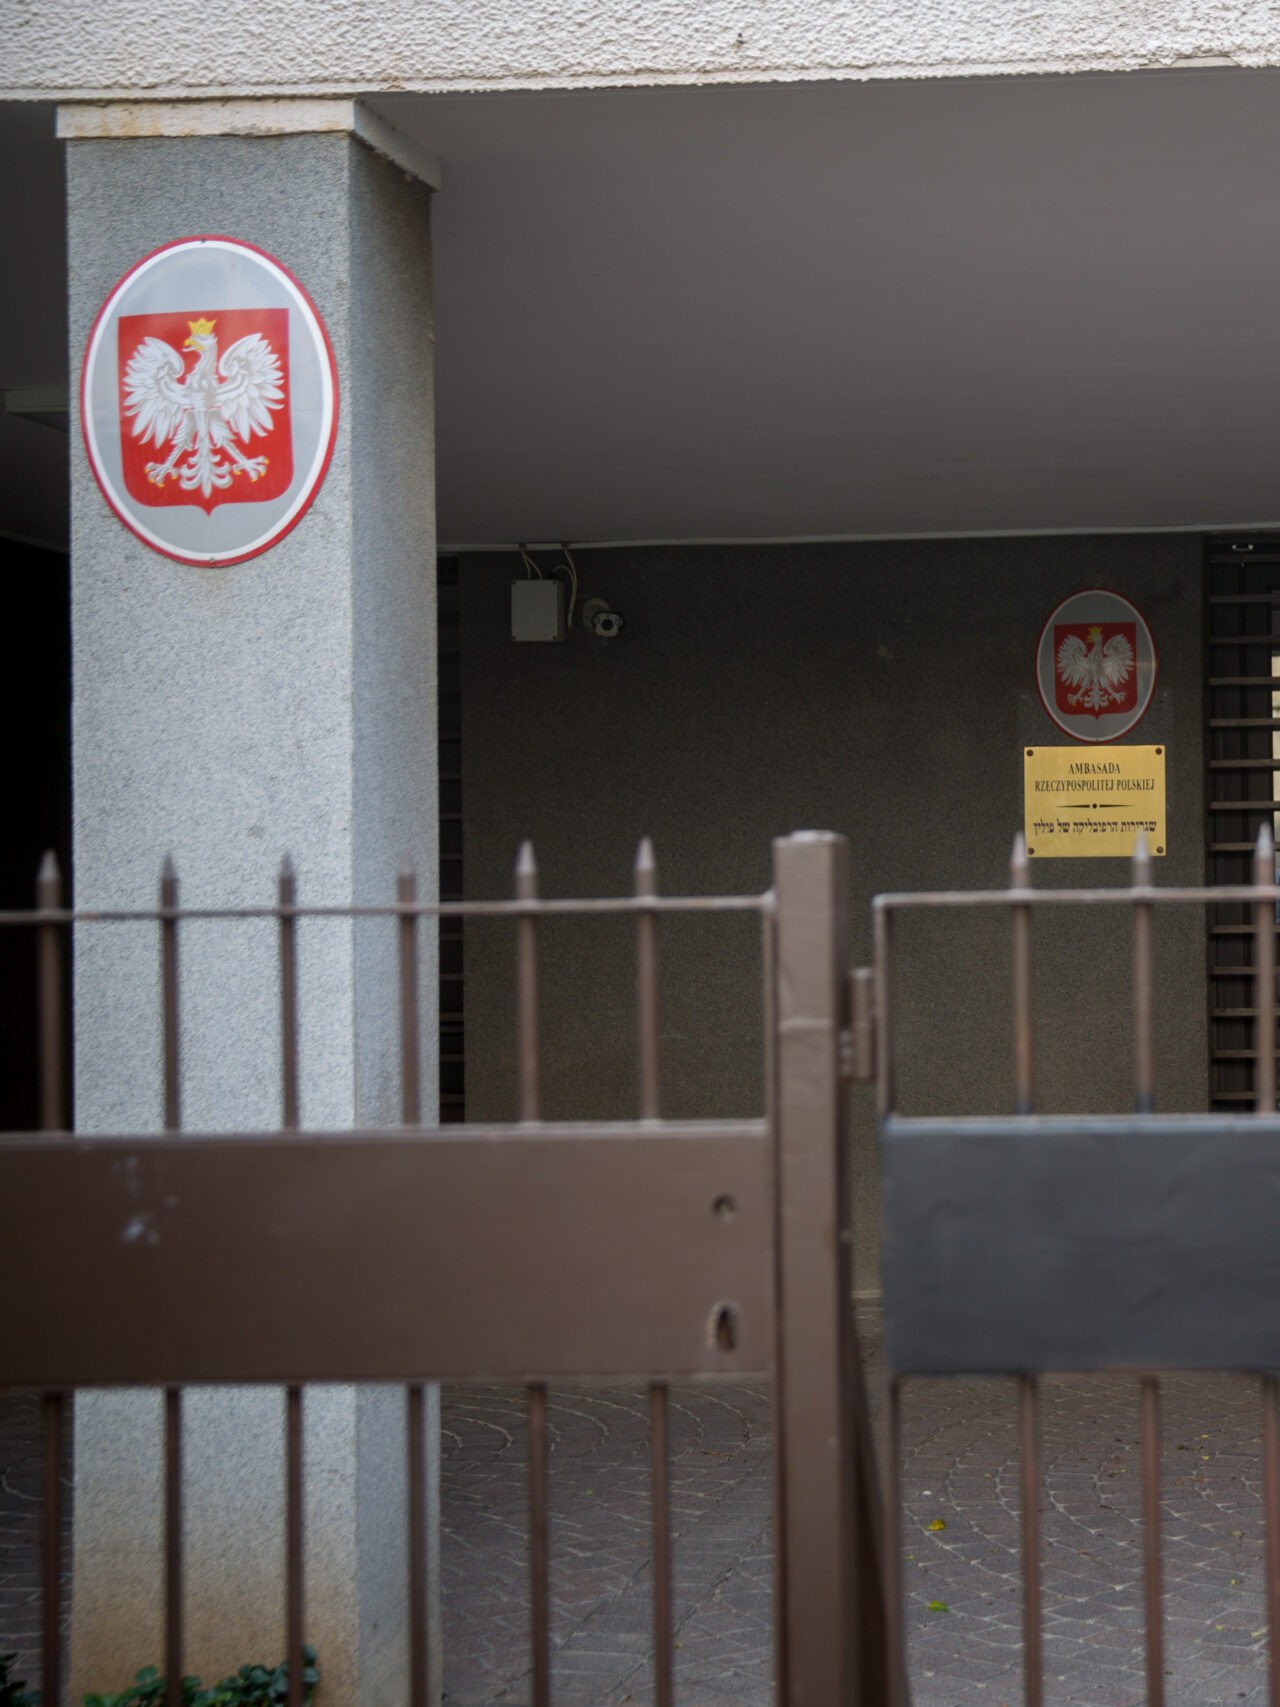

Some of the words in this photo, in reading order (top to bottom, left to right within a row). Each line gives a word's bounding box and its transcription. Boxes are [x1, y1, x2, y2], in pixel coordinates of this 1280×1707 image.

[1068, 762, 1121, 775] AMBASADA
[1035, 779, 1114, 792] RZECZYPOSPOLITEJ
[1116, 778, 1155, 791] POLSKIEJ
[1033, 818, 1055, 836] פולין
[1056, 818, 1070, 833] של
[1072, 817, 1118, 836] הרפובליקה
